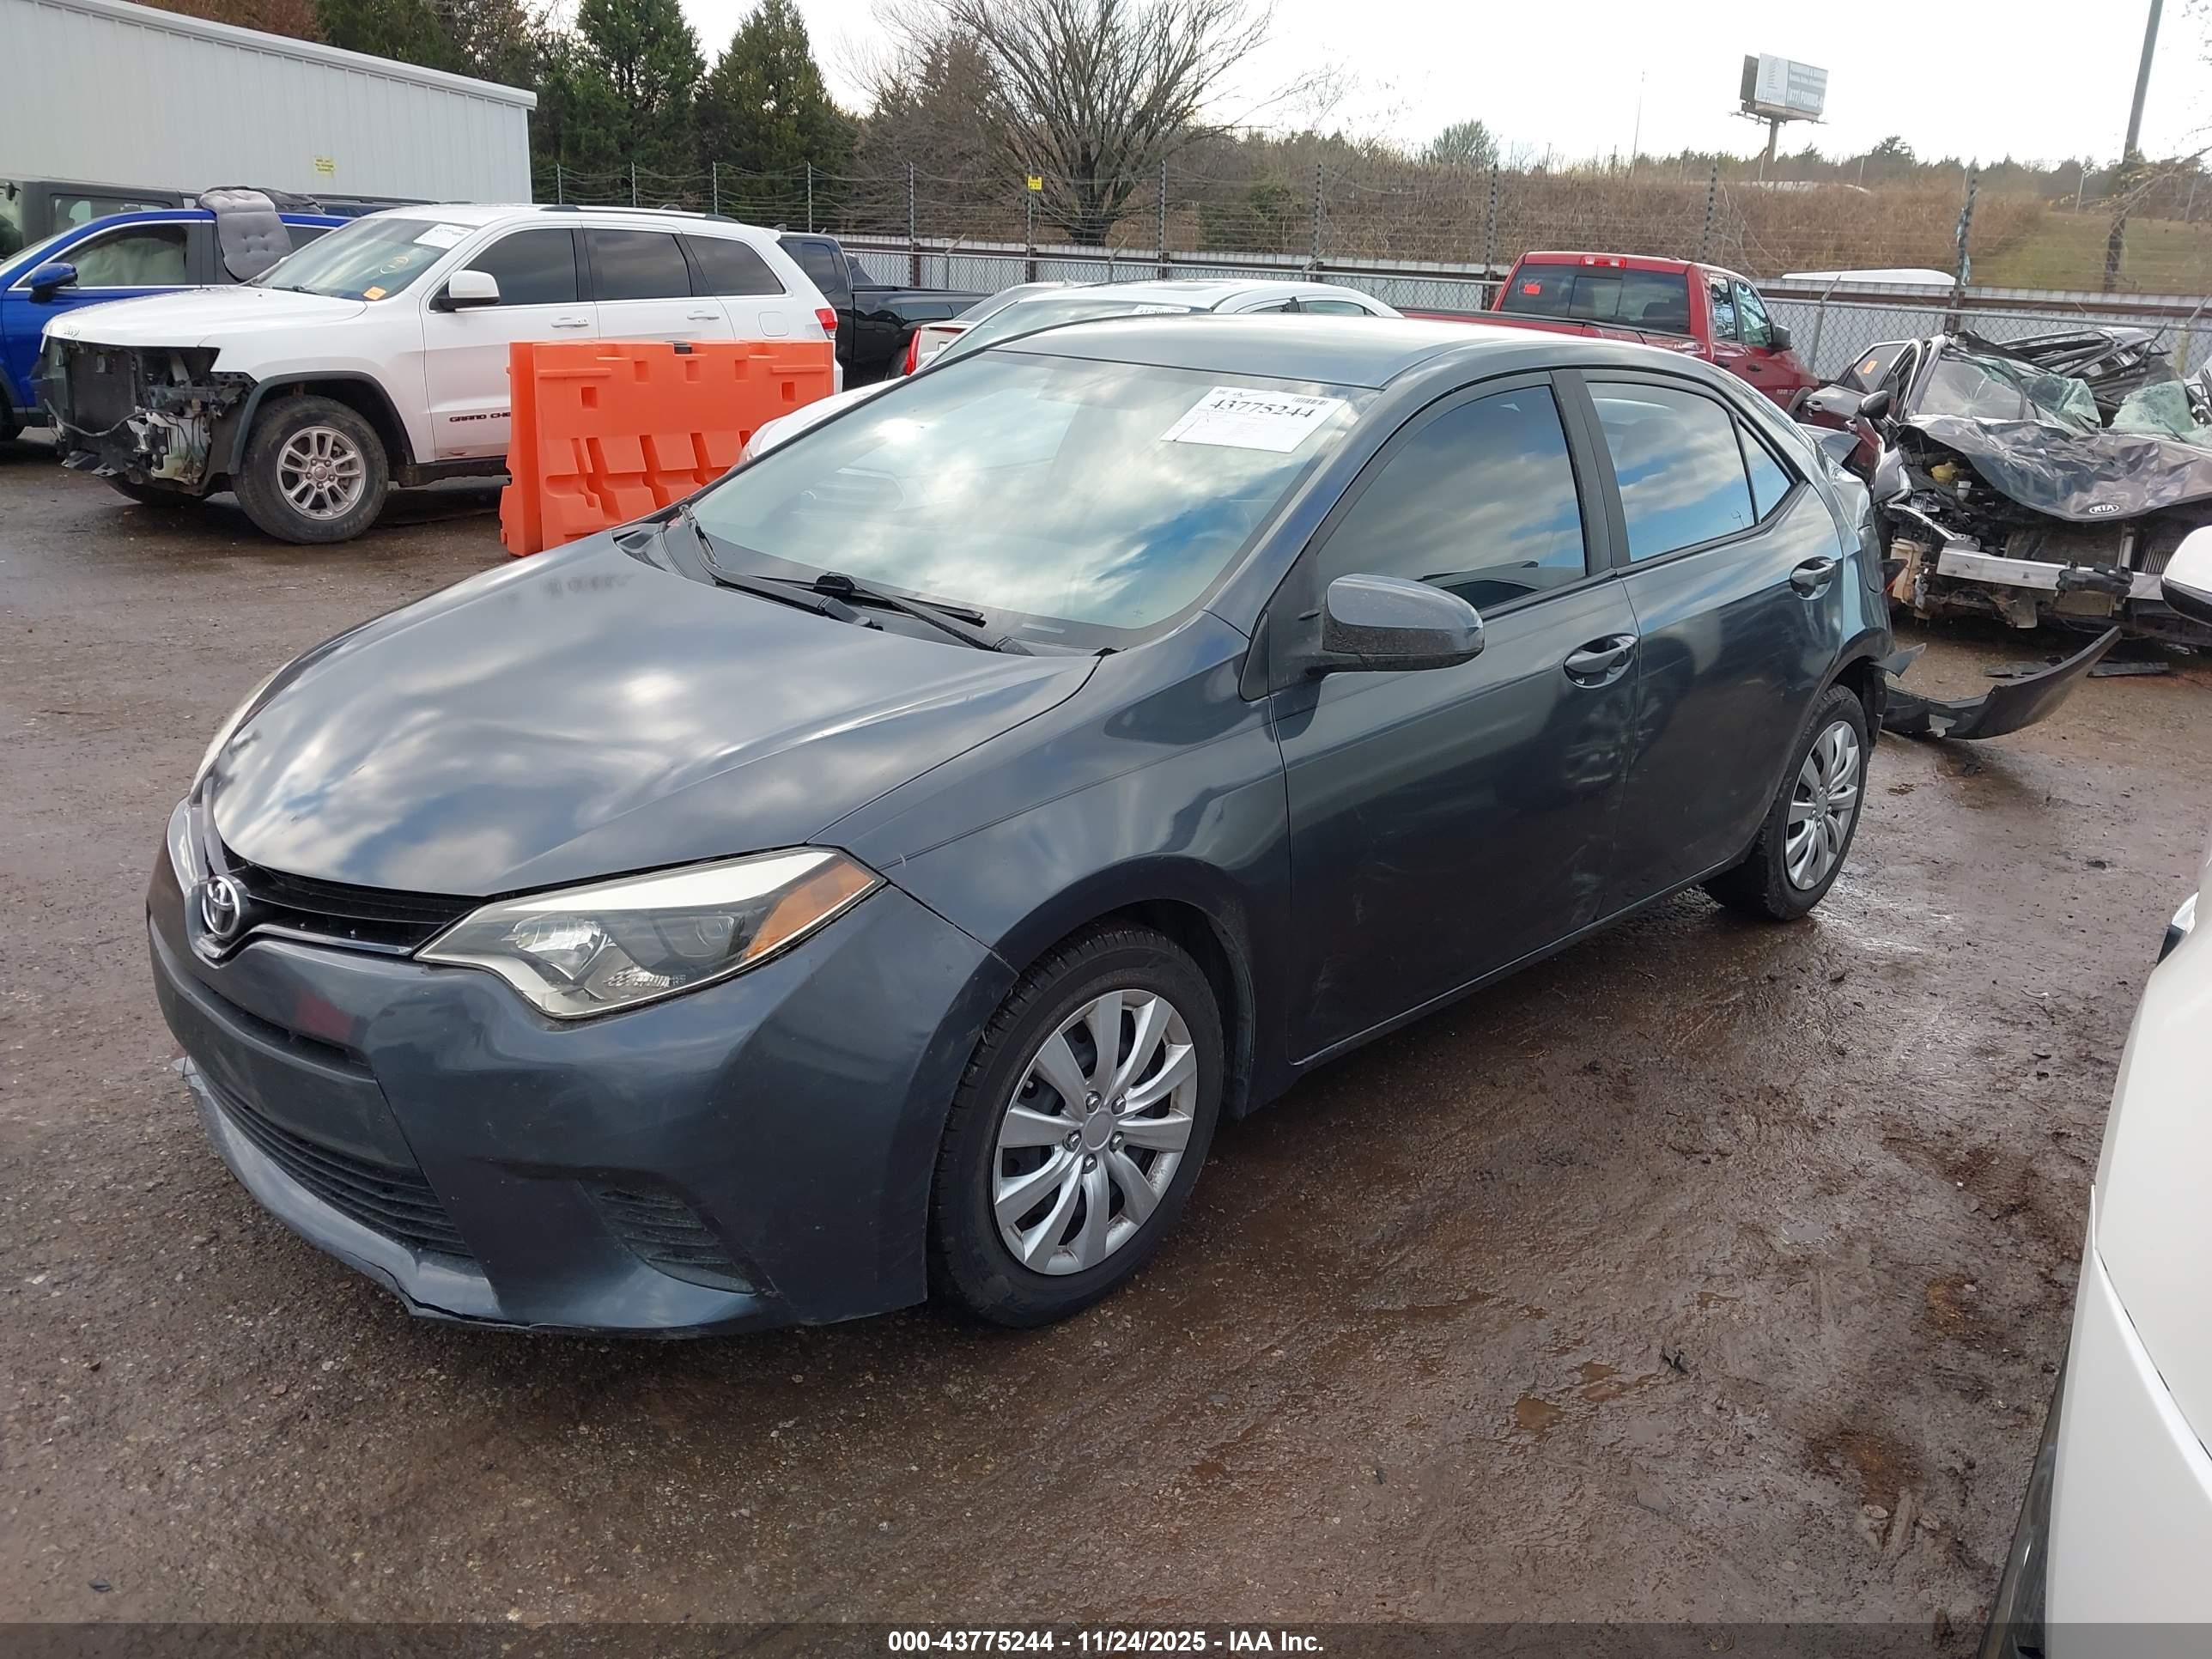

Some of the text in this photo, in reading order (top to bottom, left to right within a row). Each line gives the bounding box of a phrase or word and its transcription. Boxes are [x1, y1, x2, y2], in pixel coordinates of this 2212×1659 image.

[1210, 399, 1316, 417] 43775244
[449, 414, 487, 422] GRAND
[2093, 504, 2115, 513] KIA
